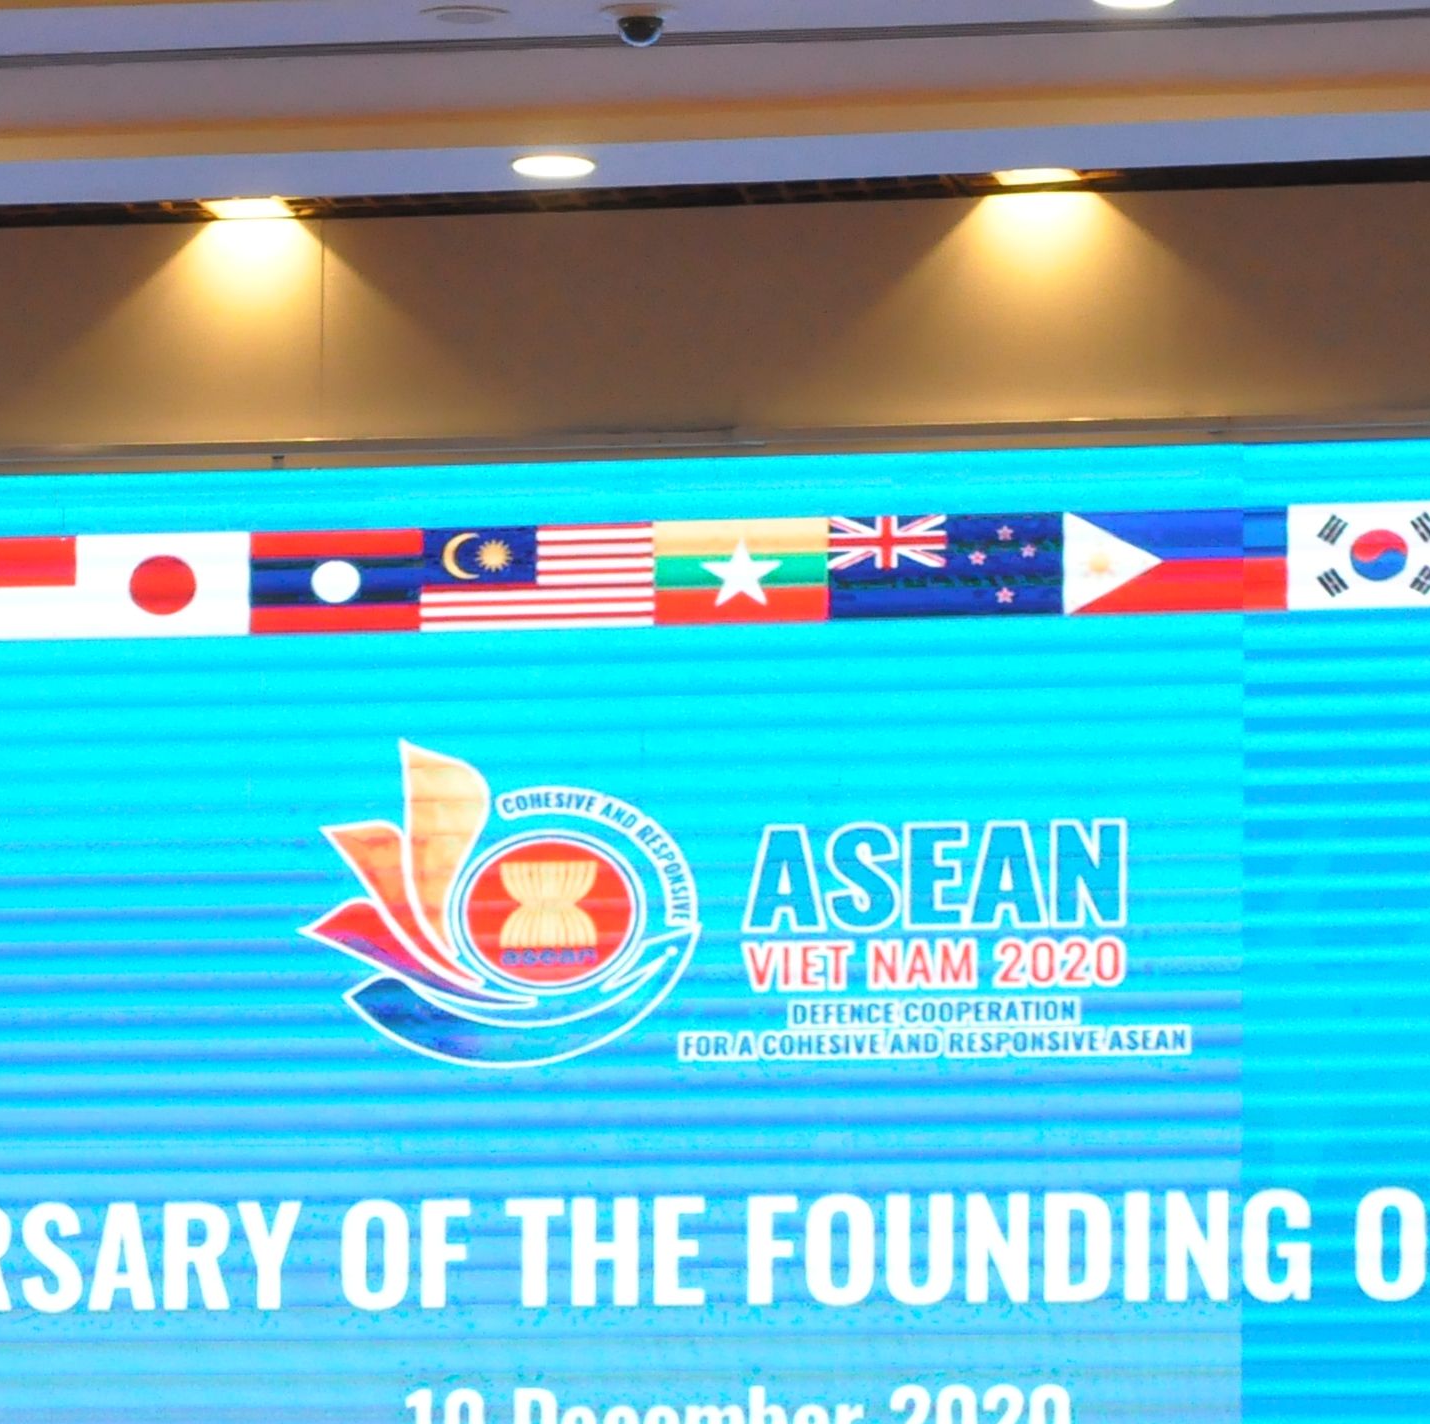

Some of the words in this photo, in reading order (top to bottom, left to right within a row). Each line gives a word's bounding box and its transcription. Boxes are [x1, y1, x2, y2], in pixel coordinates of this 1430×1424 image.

[501, 791, 597, 814] COHESIVE
[600, 802, 637, 829] AND
[636, 824, 691, 921] RESPONSIVE
[741, 818, 1127, 933] ASEAN
[745, 944, 851, 987] VIET
[872, 942, 974, 986] NAM
[998, 940, 1122, 984] 2020
[683, 1034, 735, 1058] FOR
[737, 1034, 754, 1057] A
[762, 1032, 880, 1056] COHESIVE
[888, 1031, 940, 1055] AND
[948, 1030, 1100, 1055] RESPONSIVE
[1107, 1028, 1188, 1053] ASEAN
[791, 1002, 895, 1026] DEFENCE
[904, 999, 1076, 1024] COOPERATION
[340, 1198, 471, 1312] OF
[505, 1194, 707, 1308] THE
[746, 1187, 1314, 1307] FOUNDING
